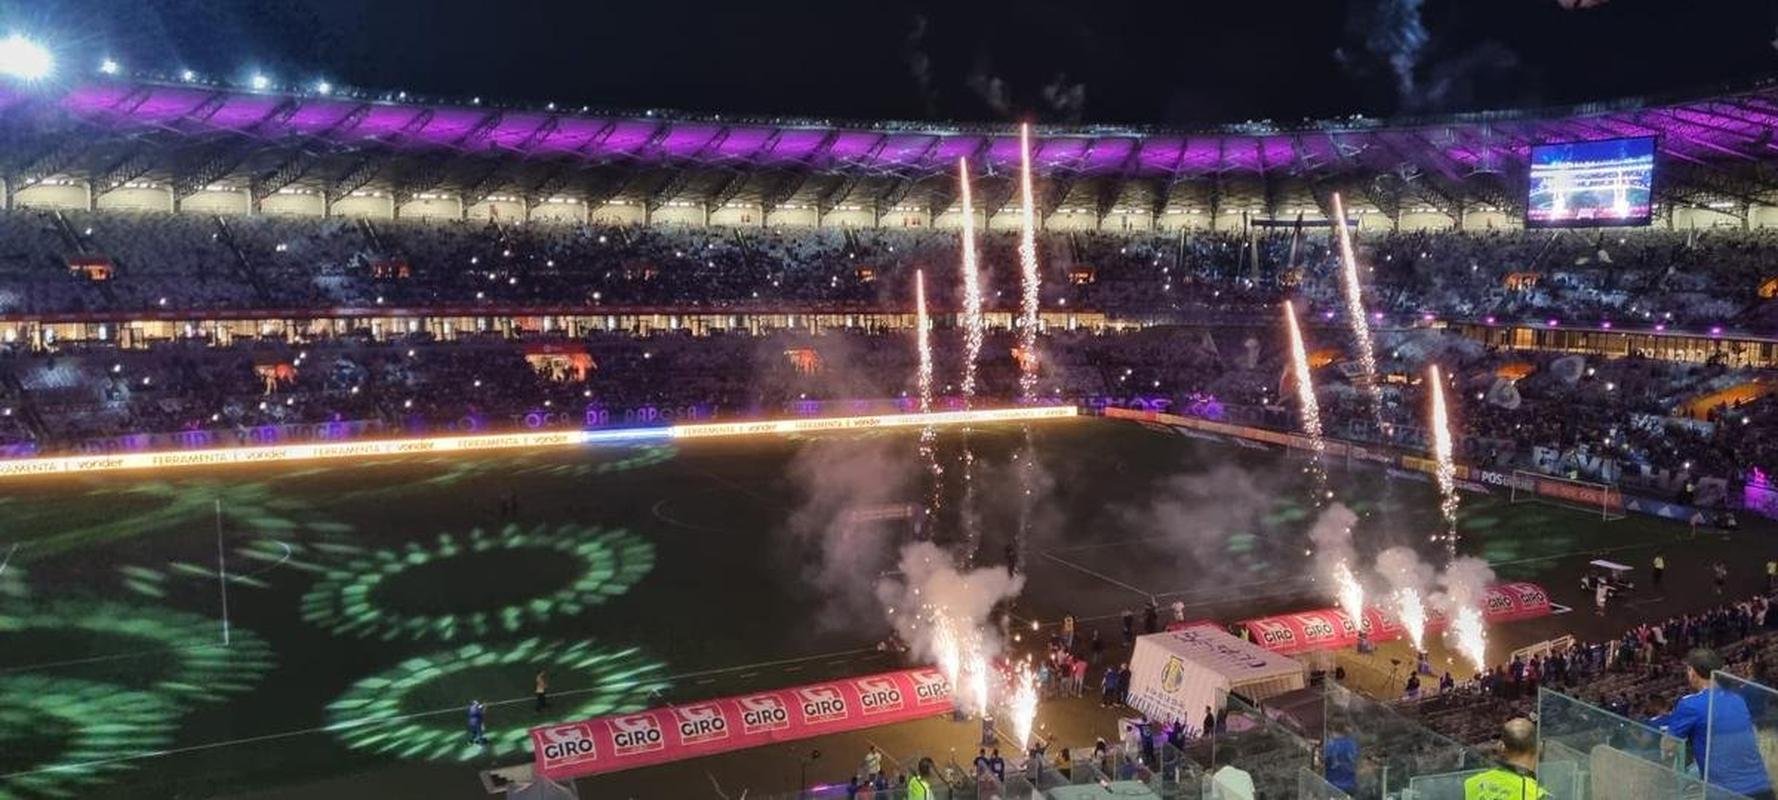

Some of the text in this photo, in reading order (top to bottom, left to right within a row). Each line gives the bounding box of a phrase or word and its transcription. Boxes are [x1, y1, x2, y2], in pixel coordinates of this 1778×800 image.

[1304, 623, 1332, 637] GIRO
[1343, 617, 1371, 632] GIO
[1263, 629, 1293, 643] GIRO
[861, 690, 900, 707] GIRO
[744, 708, 786, 726] GIRO
[804, 699, 844, 717] GIRO
[681, 717, 725, 737] GIRO
[614, 728, 661, 748] GIRO
[544, 739, 593, 760] GIRO
